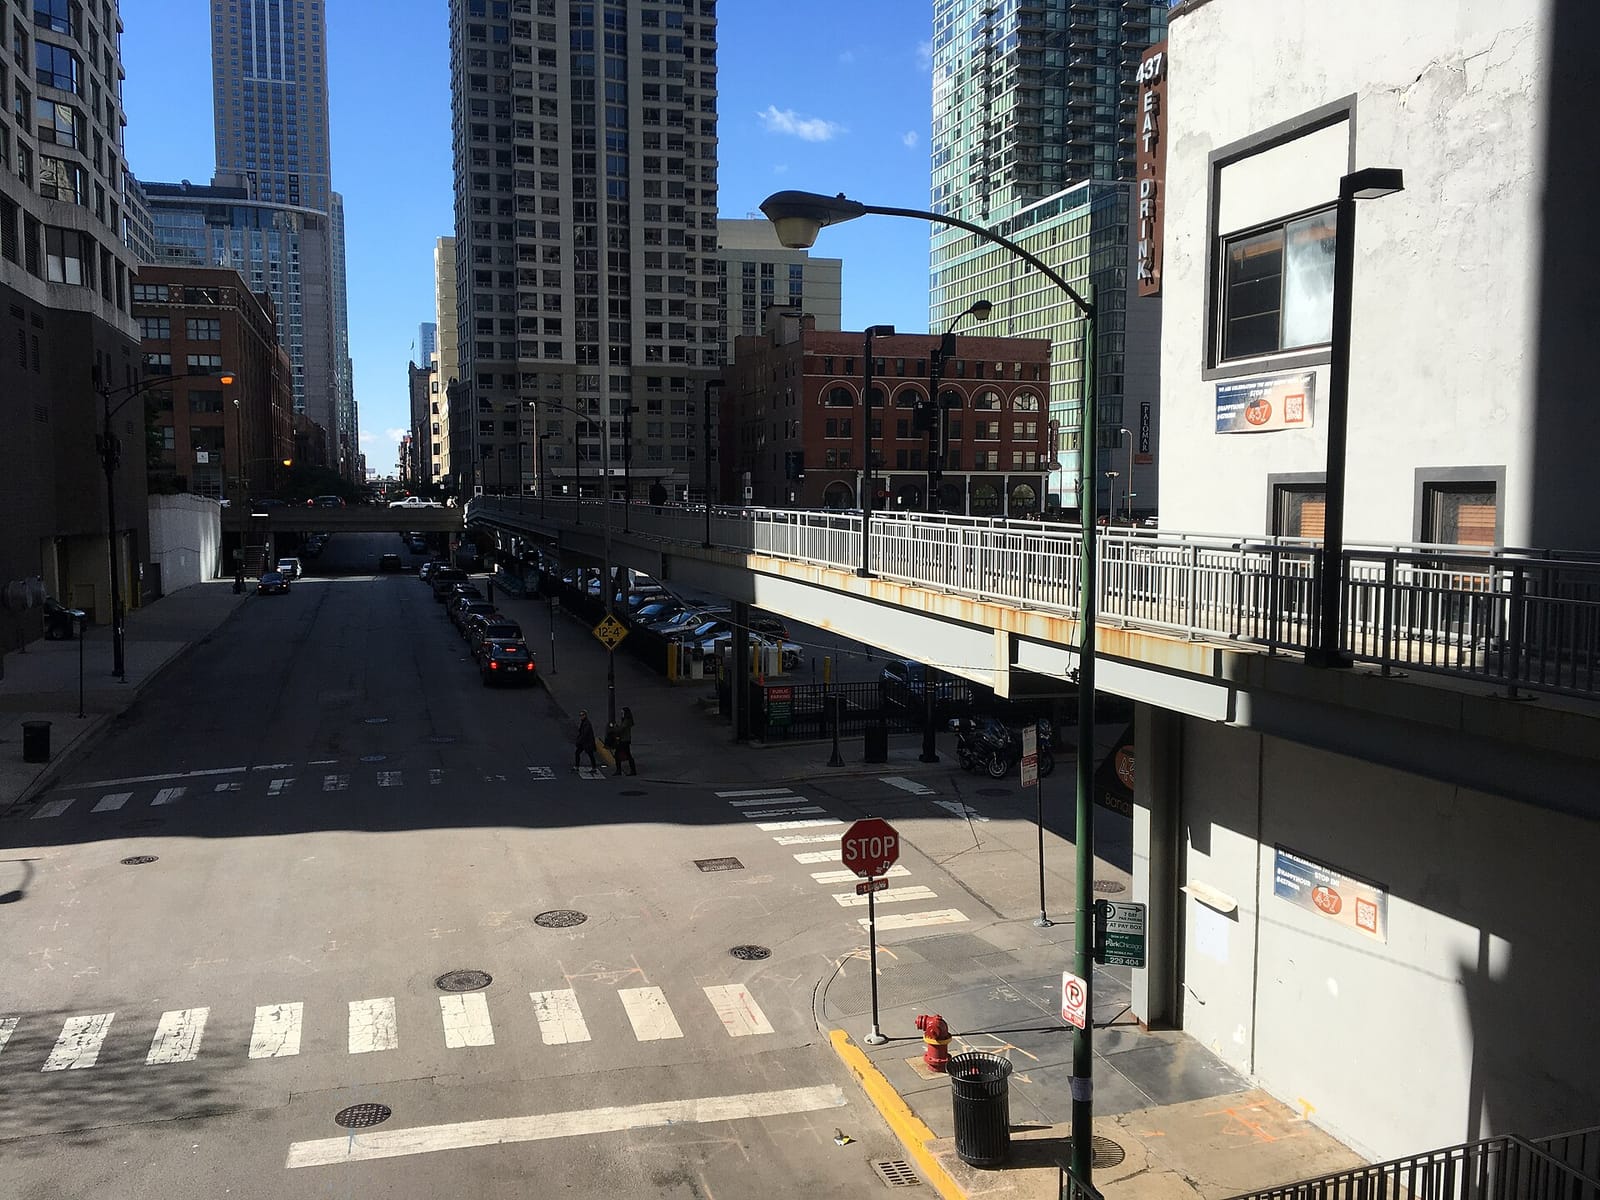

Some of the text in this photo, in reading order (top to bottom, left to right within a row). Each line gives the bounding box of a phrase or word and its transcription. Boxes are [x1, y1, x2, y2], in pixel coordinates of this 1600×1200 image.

[1136, 52, 1162, 84] 437
[1137, 90, 1154, 280] EAT DRINK
[845, 836, 895, 860] STOP
[1314, 871, 1330, 884] STOP
[1316, 892, 1338, 913] 437
[1105, 940, 1142, 951] ParkChicago
[1109, 957, 1139, 967] 229 404
